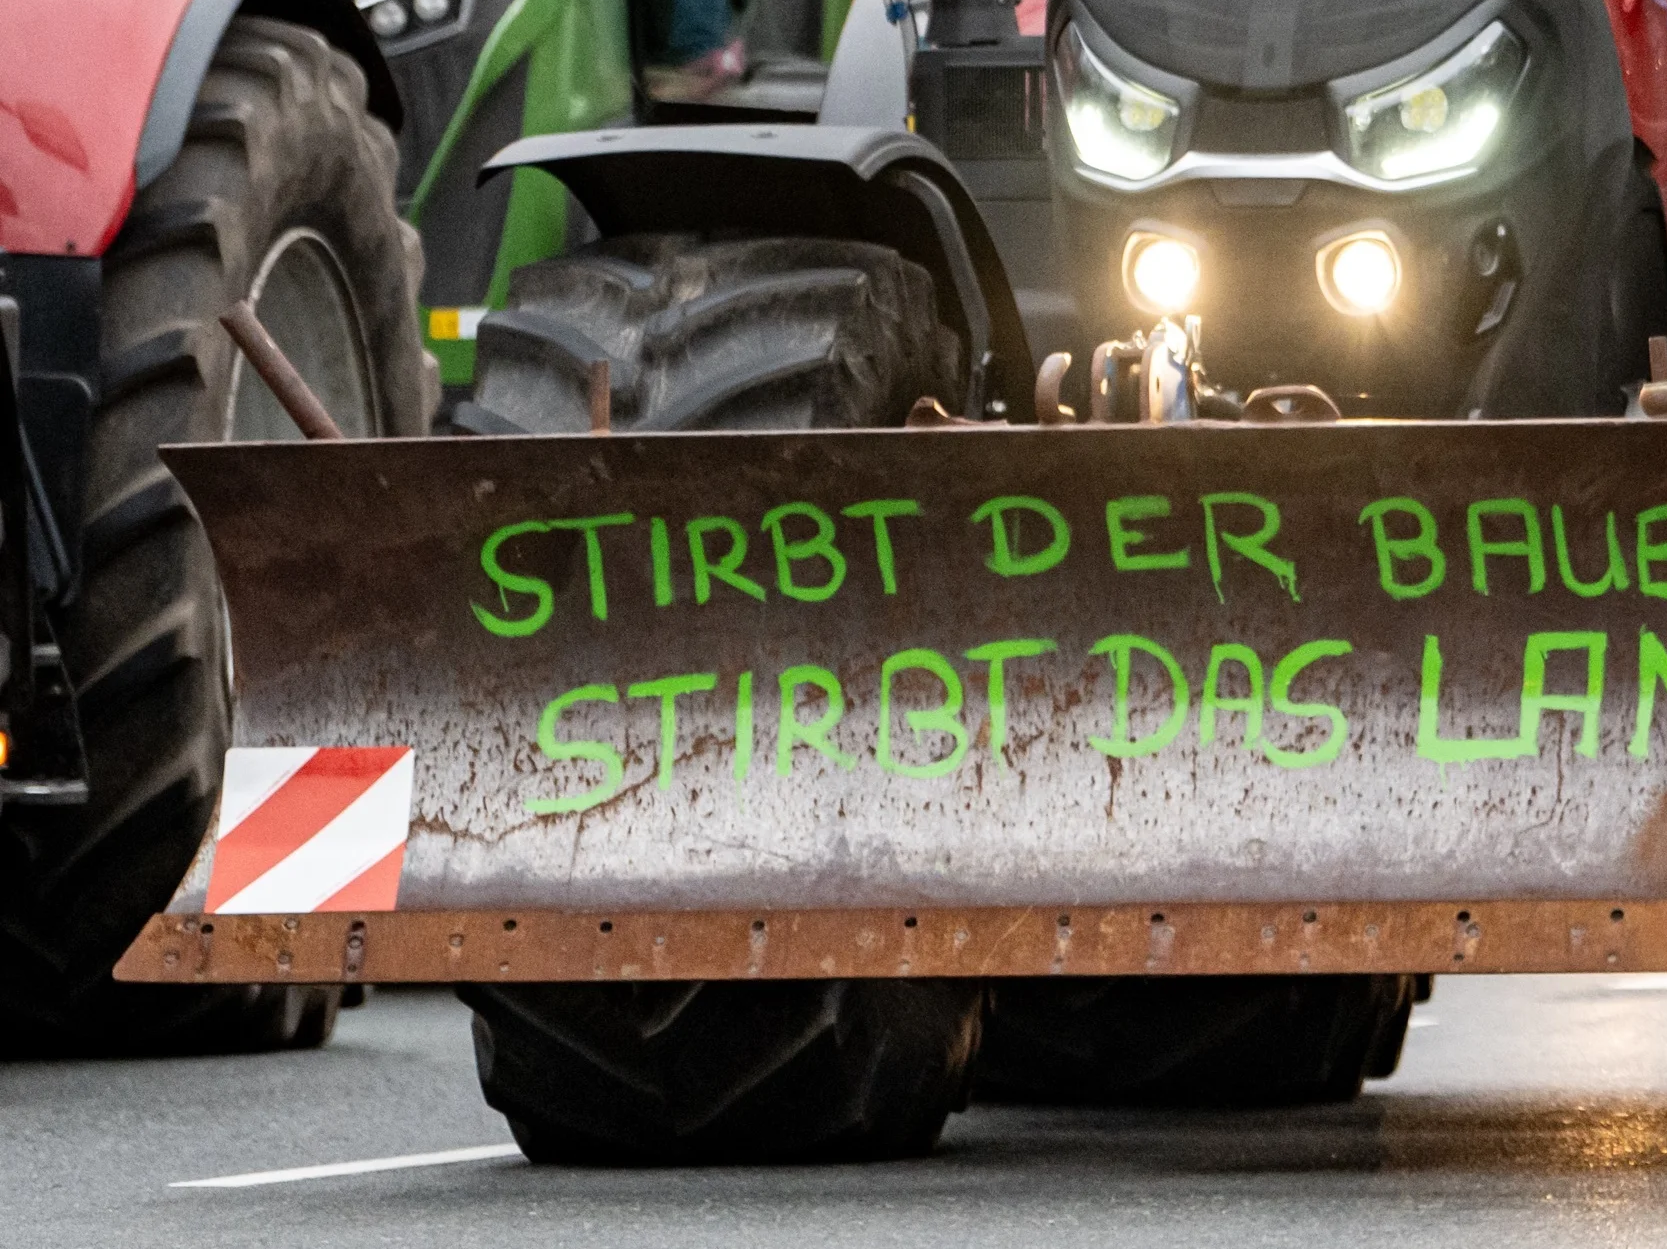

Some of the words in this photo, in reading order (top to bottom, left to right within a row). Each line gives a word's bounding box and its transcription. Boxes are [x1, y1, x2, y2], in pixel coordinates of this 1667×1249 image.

[471, 499, 922, 637] STIRBT
[970, 493, 1301, 603] DER
[525, 637, 1057, 816] STIRBT
[1087, 633, 1353, 768] DAS
